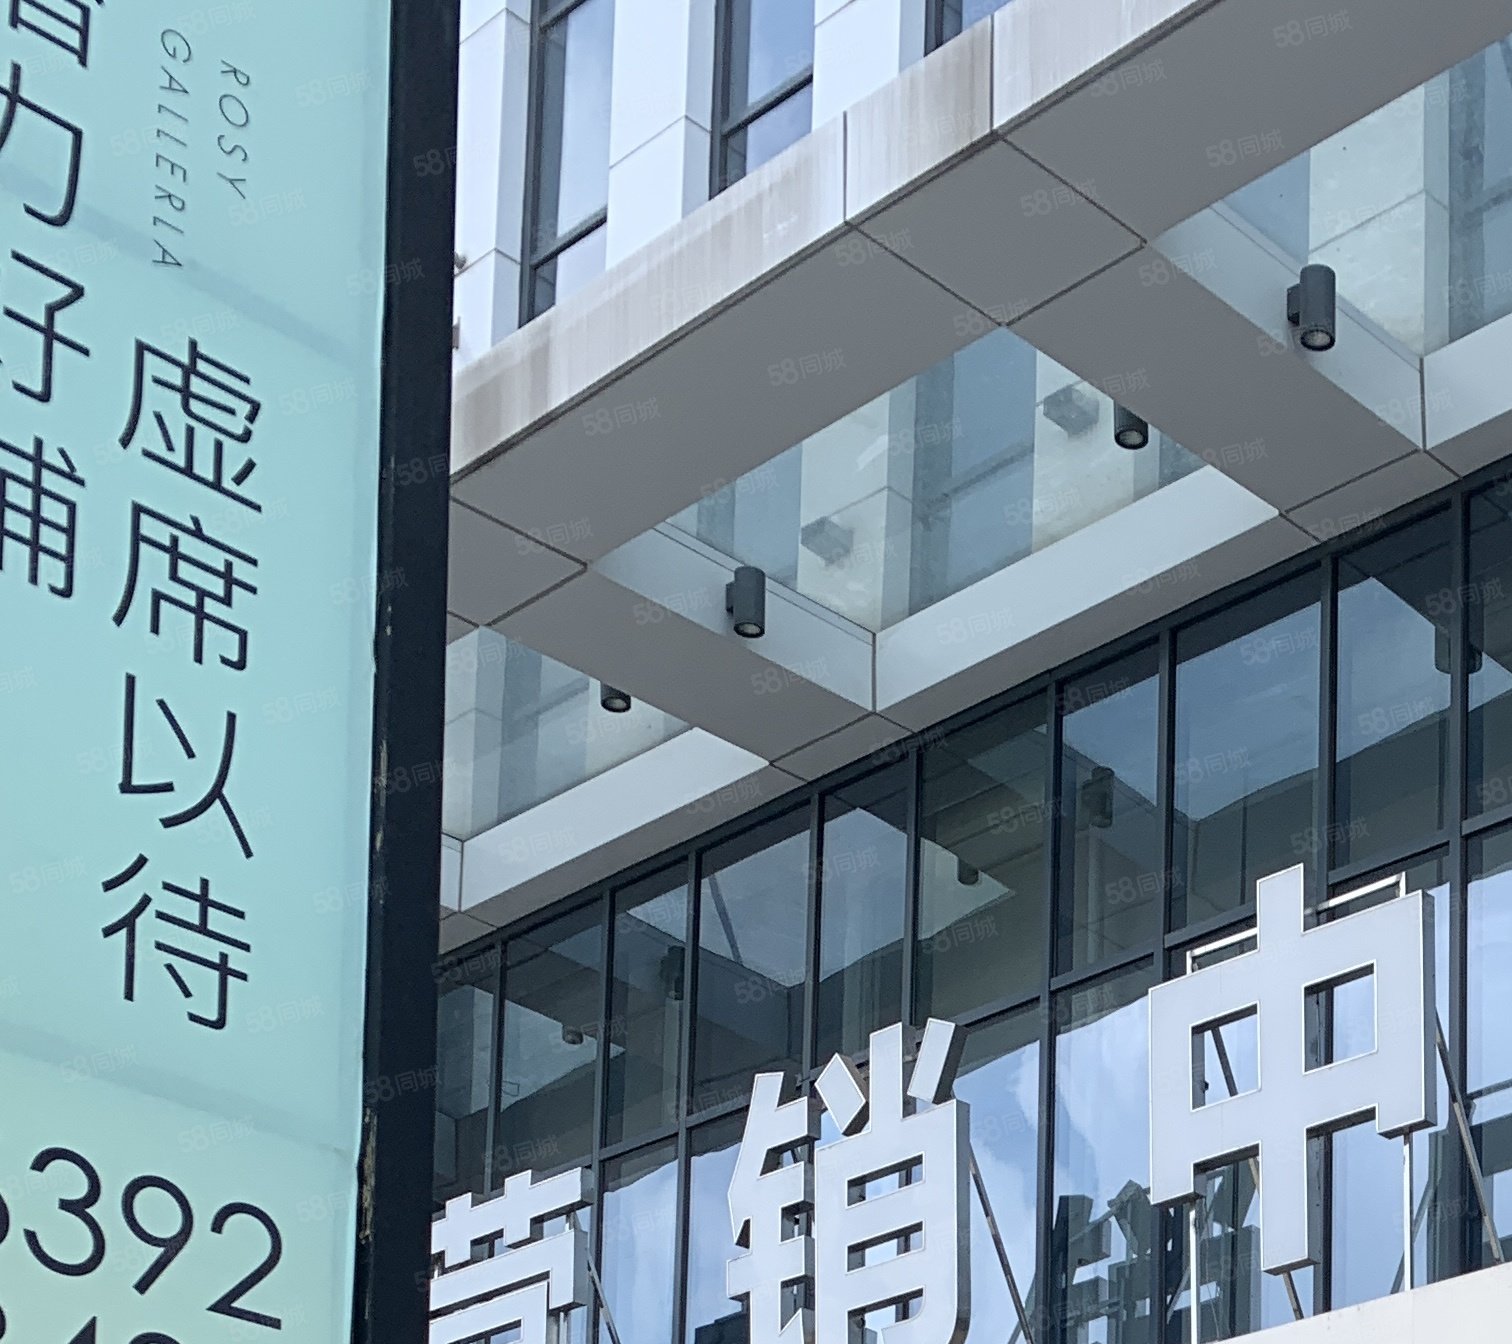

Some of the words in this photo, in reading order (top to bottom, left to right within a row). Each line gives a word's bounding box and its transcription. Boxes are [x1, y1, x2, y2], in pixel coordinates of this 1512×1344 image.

[216, 59, 251, 200] ROSY
[101, 337, 262, 1031] 虚席以待
[0, 1146, 283, 1330] 392
